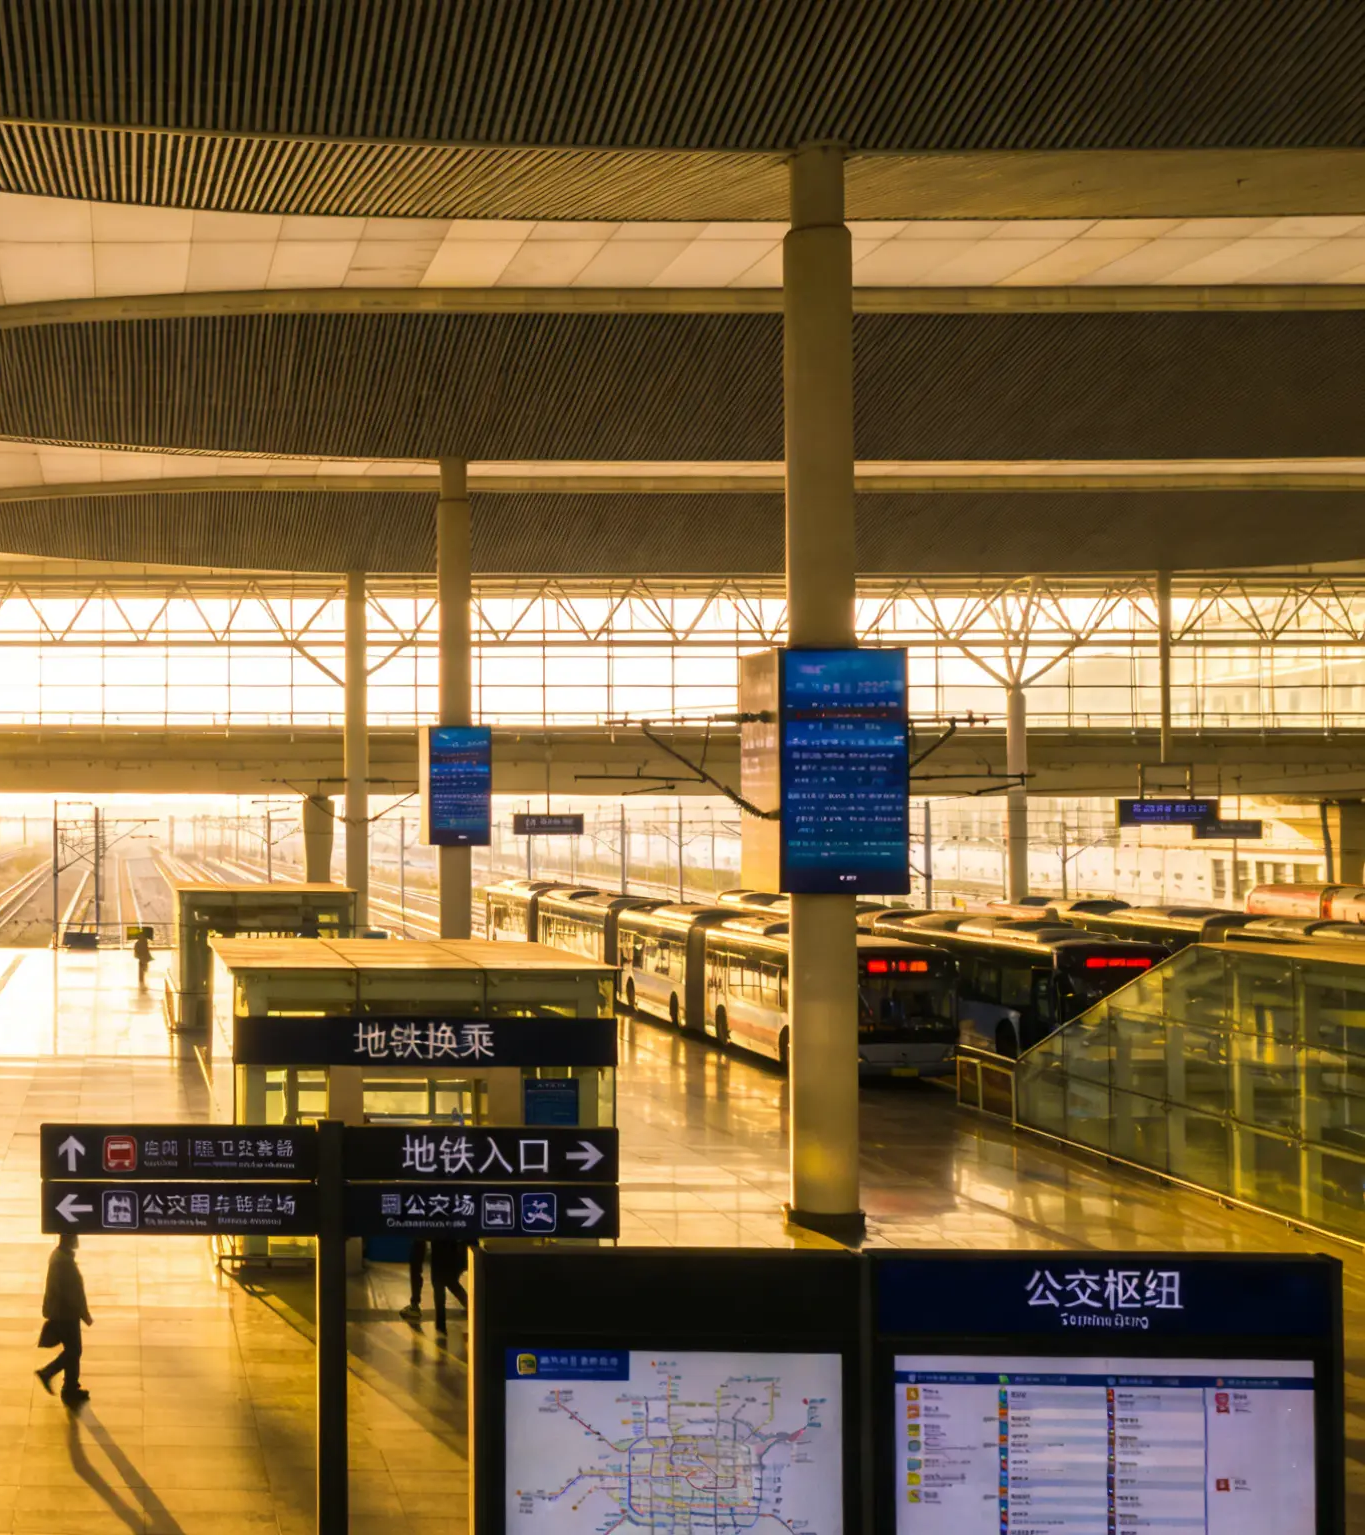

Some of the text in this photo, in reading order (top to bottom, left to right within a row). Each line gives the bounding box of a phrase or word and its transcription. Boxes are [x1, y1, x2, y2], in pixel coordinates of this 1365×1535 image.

[353, 1021, 496, 1060] 地铁换乘
[402, 1134, 549, 1174] 地铁入口
[1025, 1268, 1184, 1311] 公交枢纽
